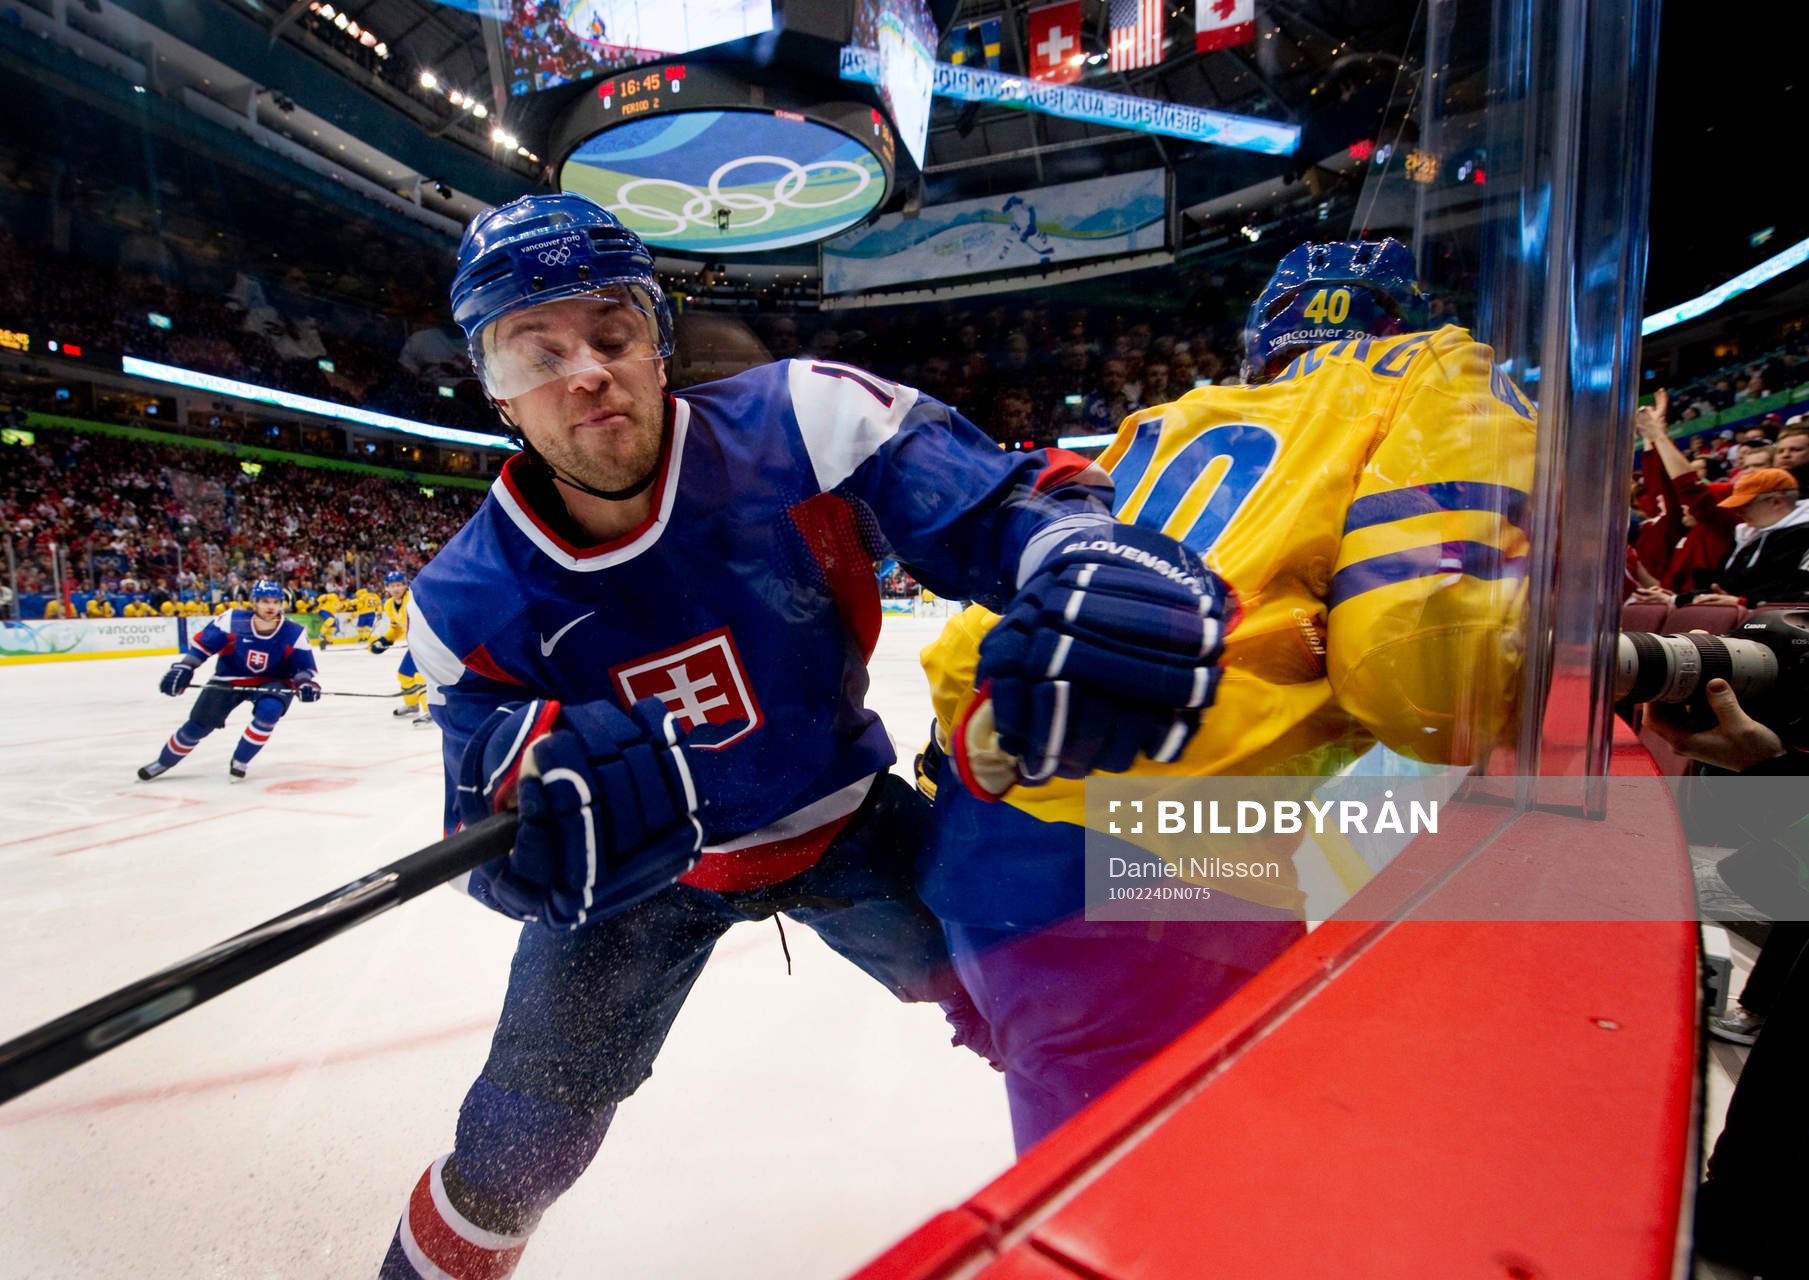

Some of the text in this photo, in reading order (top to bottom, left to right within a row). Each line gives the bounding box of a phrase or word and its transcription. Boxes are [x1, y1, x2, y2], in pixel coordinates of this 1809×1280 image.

[620, 73, 660, 98] 16:45
[621, 100, 650, 116] PERIOD
[520, 234, 581, 253] vancouver 2010
[1303, 289, 1351, 324] 40
[1268, 328, 1342, 347] vancouver
[97, 624, 166, 635] vancouver
[119, 634, 150, 645] 2010
